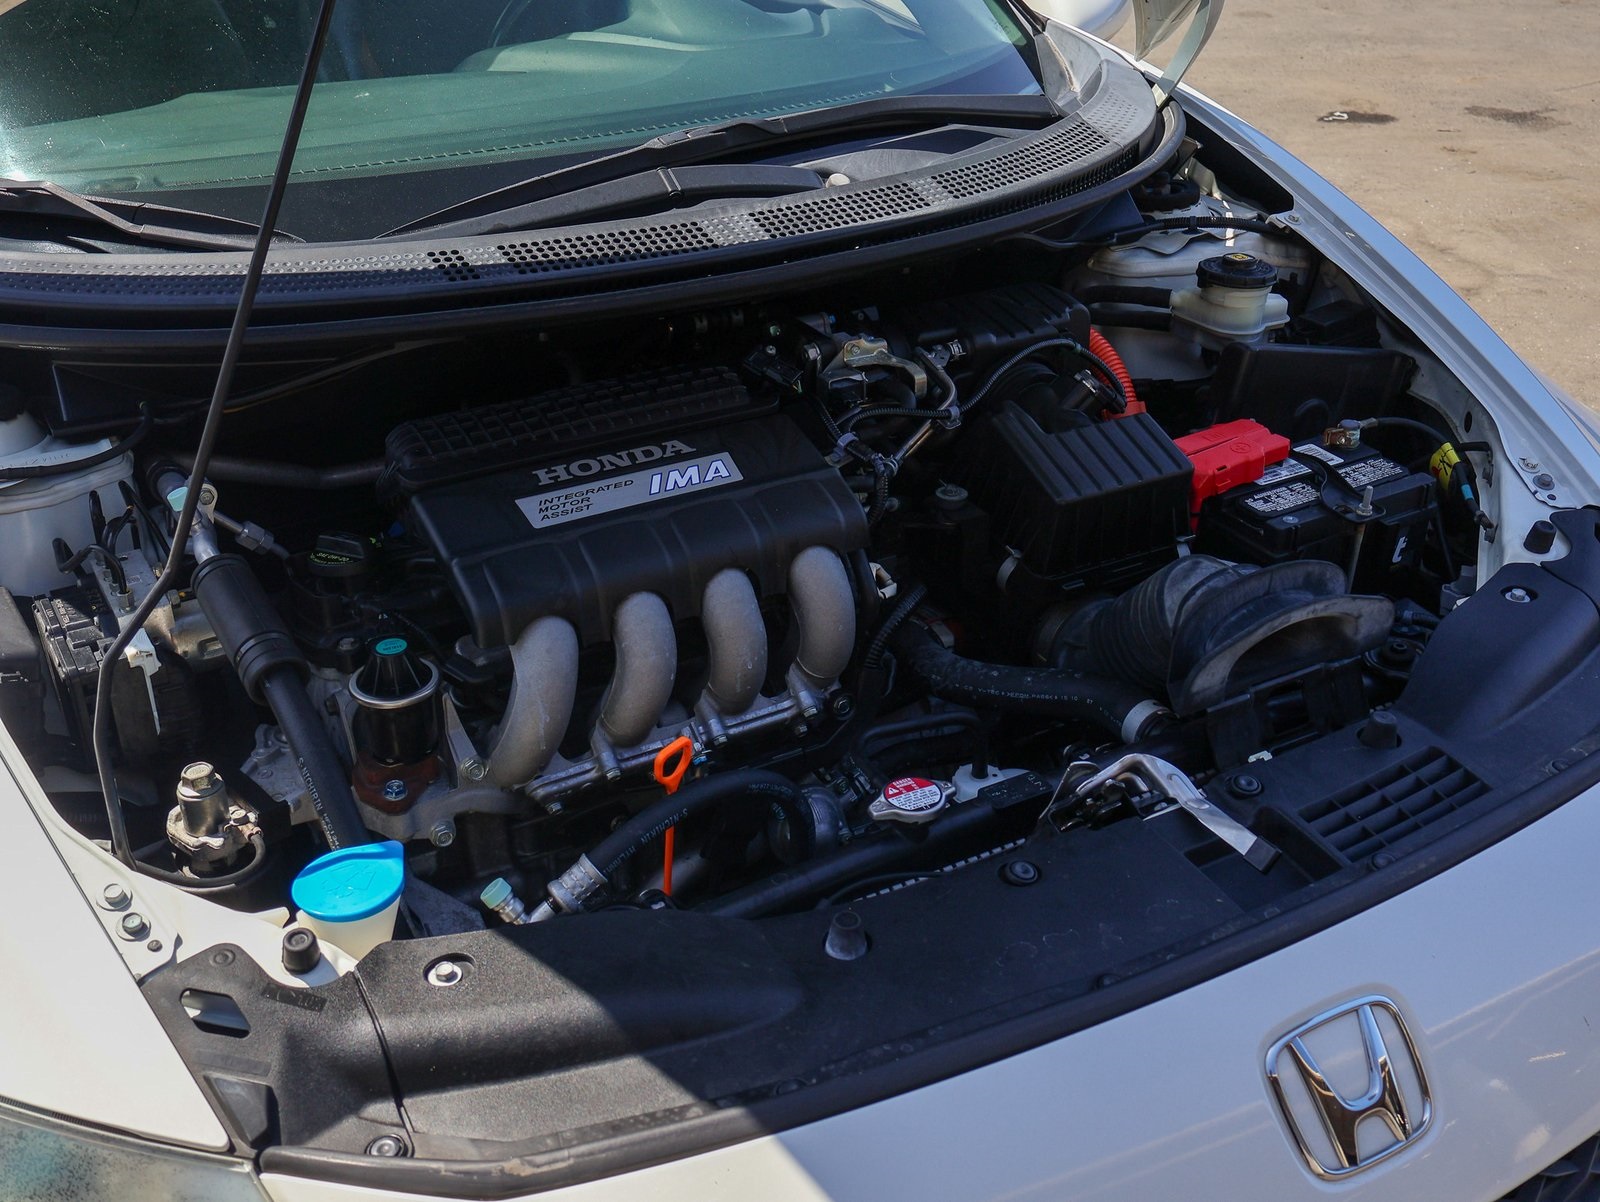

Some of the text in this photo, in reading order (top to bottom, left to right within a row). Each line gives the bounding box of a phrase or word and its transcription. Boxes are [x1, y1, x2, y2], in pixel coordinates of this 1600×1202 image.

[531, 439, 697, 486] HONDA
[649, 458, 732, 495] IMA
[538, 479, 634, 506] INTEGRATED
[538, 497, 591, 514] MOTOR
[541, 503, 594, 522] ASSIST
